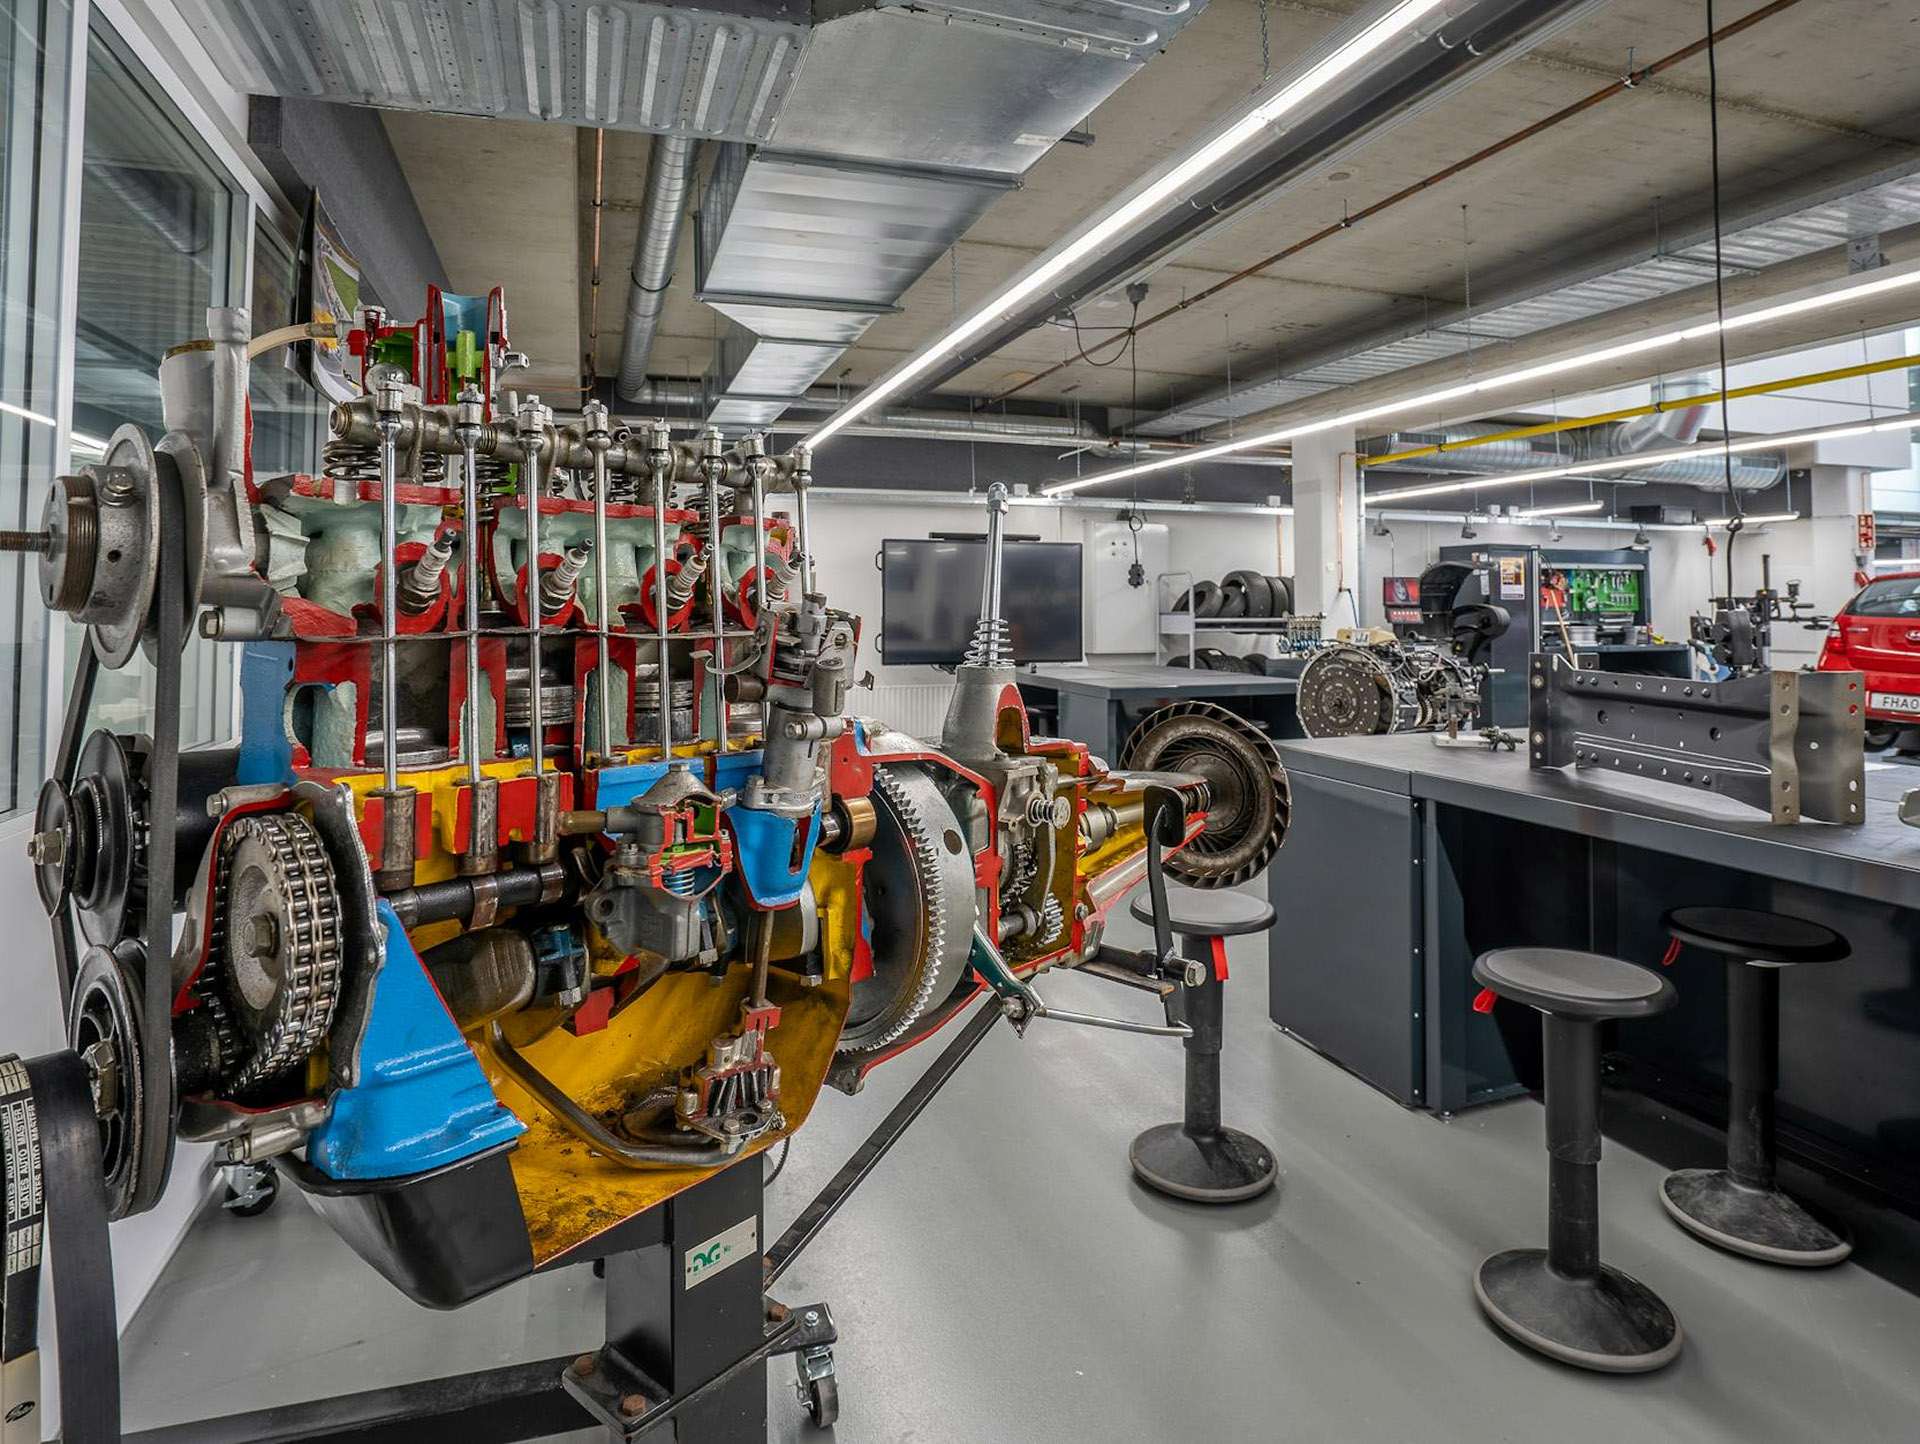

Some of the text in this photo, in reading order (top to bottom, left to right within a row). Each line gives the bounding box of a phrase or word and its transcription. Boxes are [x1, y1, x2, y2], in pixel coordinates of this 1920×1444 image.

[6, 1153, 14, 1178] AUTO
[14, 1107, 31, 1210] GATES AUTO MASTER
